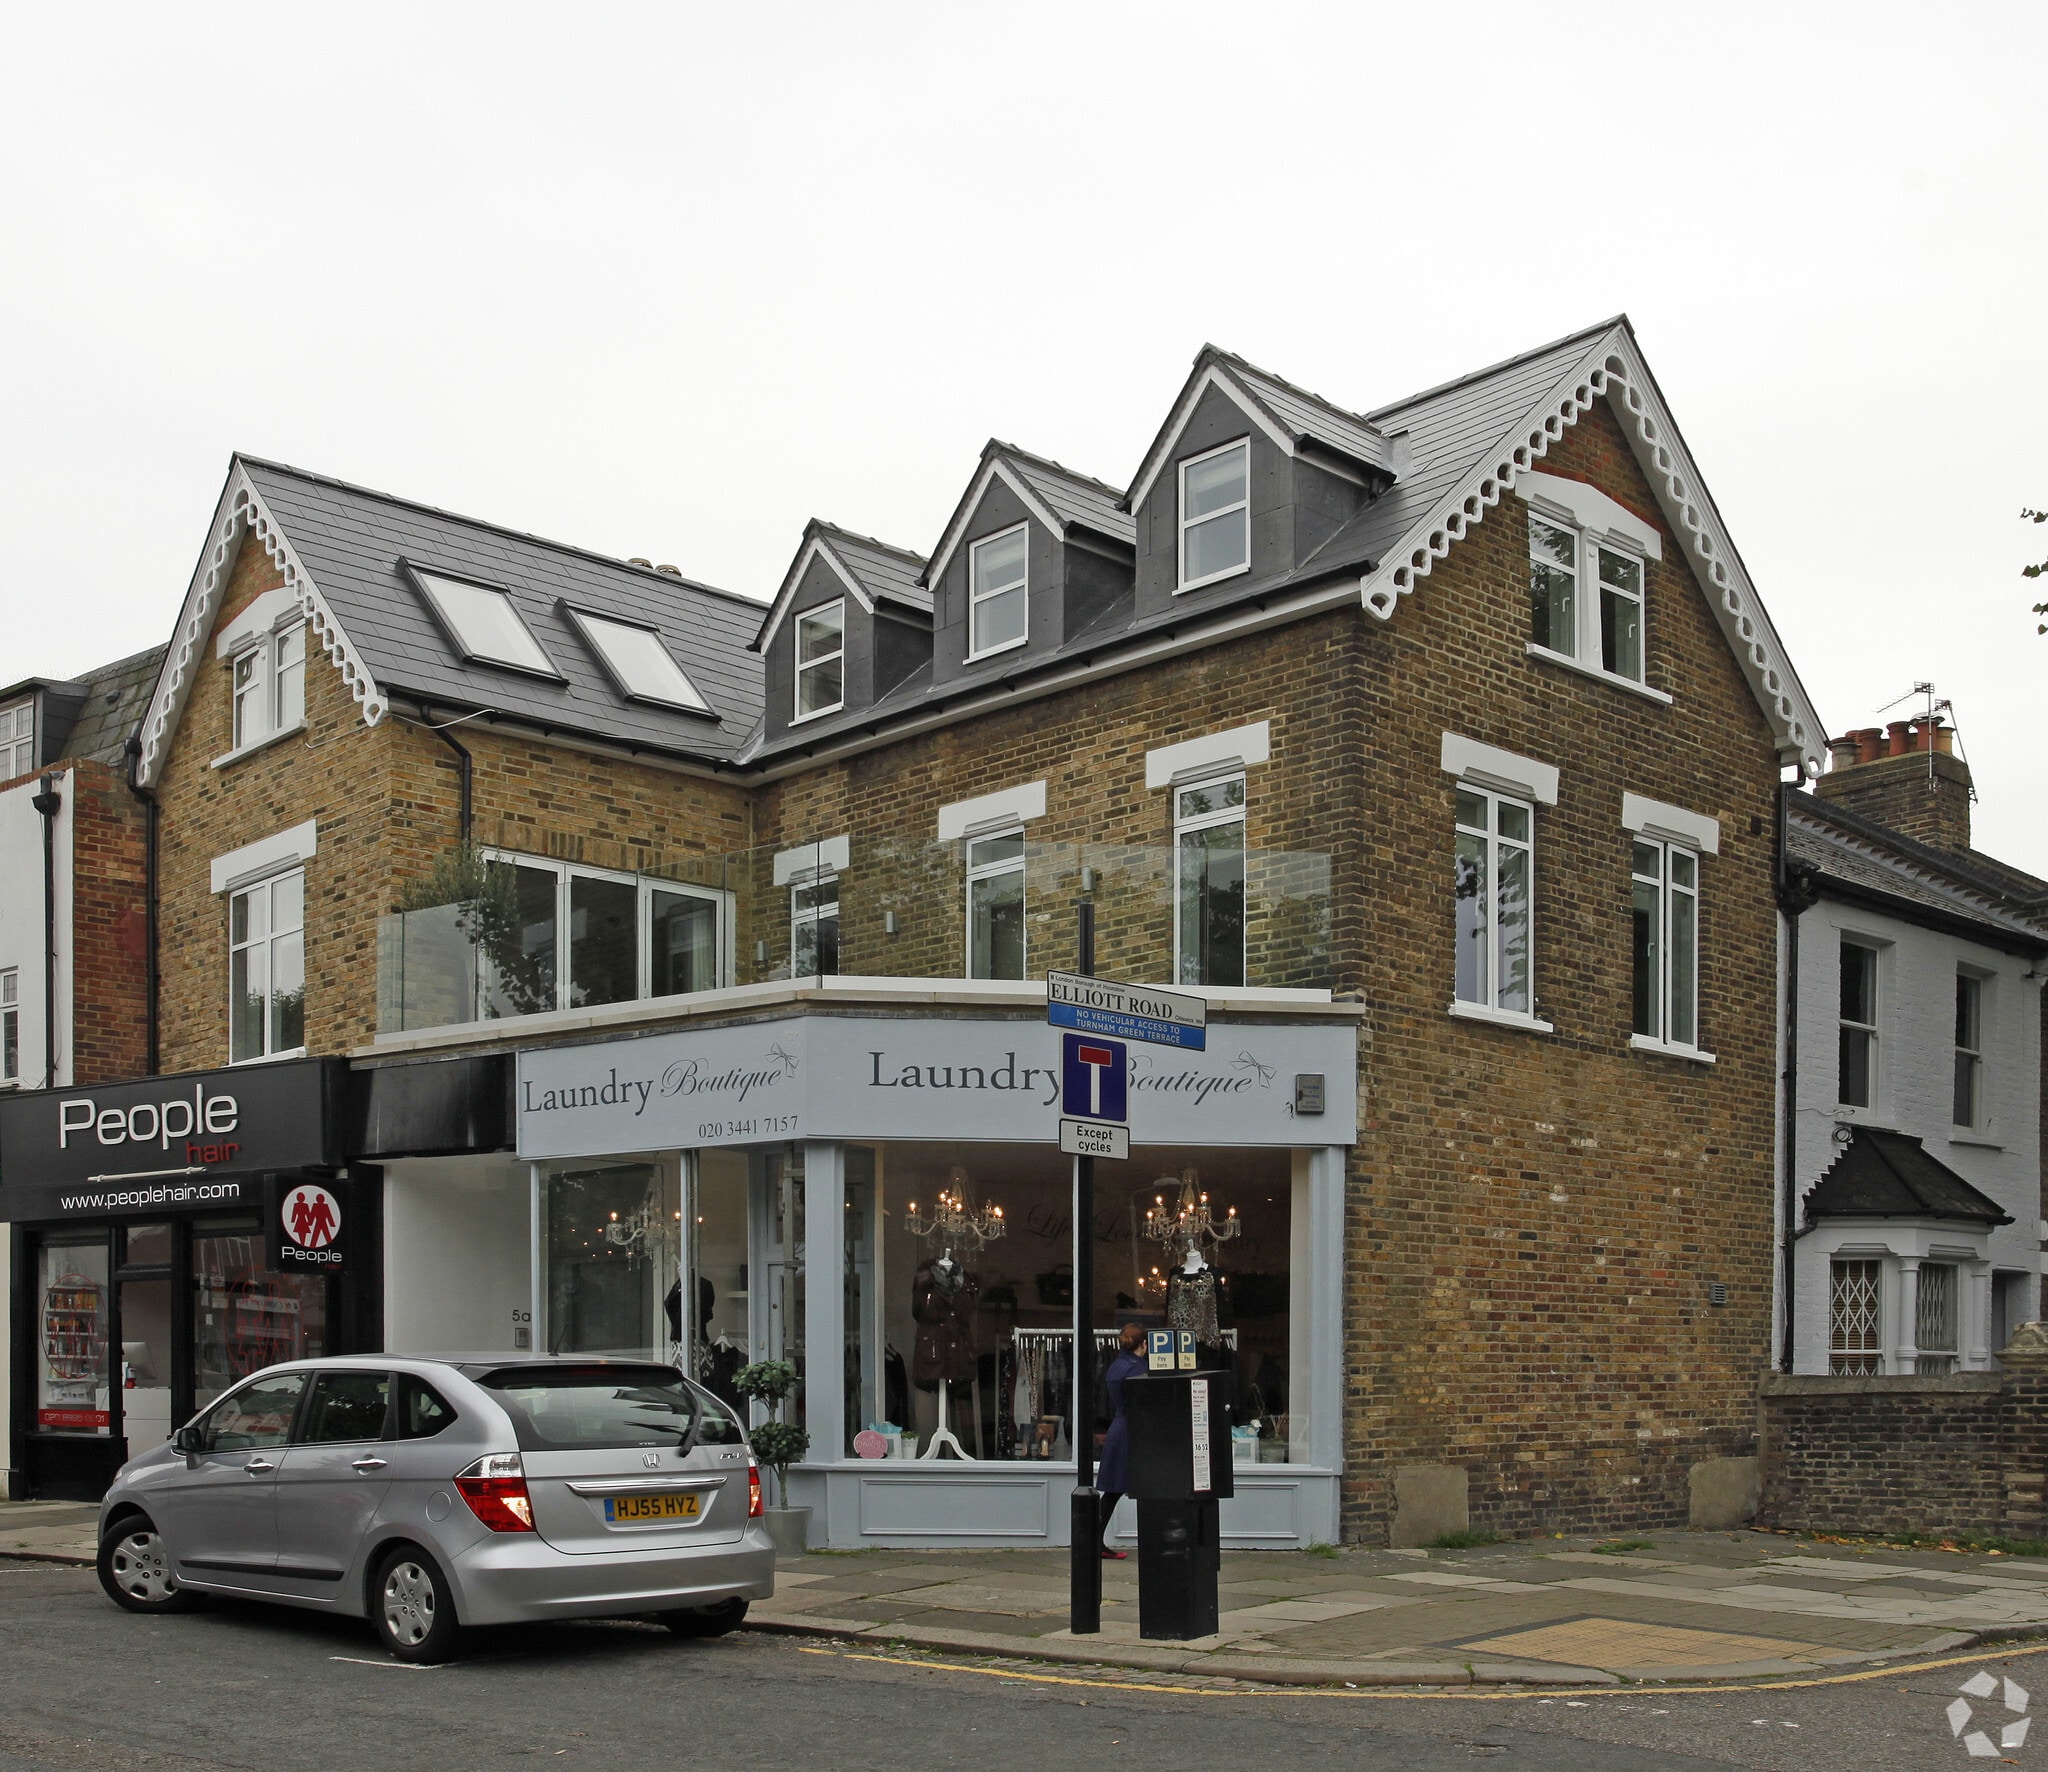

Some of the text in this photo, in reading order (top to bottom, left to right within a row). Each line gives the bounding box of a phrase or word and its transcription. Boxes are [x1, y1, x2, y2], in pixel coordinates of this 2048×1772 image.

[1051, 982, 1173, 1019] ELLIOTT ROAD
[1076, 1009, 1180, 1035] NO VEHICULAR ACCESS TO
[1076, 1018, 1181, 1044] TURNHAM GREEN TERRACE
[523, 1057, 782, 1117] Laundry Boutique
[868, 1051, 1060, 1106] Laundry
[59, 1083, 239, 1151] People
[698, 1115, 799, 1139] 020 3441 7157
[1076, 1125, 1113, 1141] Except
[186, 1139, 240, 1165] hair
[1078, 1140, 1112, 1153] cycles
[60, 1180, 240, 1210] www.peoplehair.com
[281, 1246, 343, 1264] People
[512, 1309, 531, 1322] 5a
[1153, 1332, 1169, 1353] P
[1181, 1332, 1192, 1353] P
[1157, 1355, 1167, 1363] Pay
[617, 1496, 697, 1517] HJ55 HYZ
